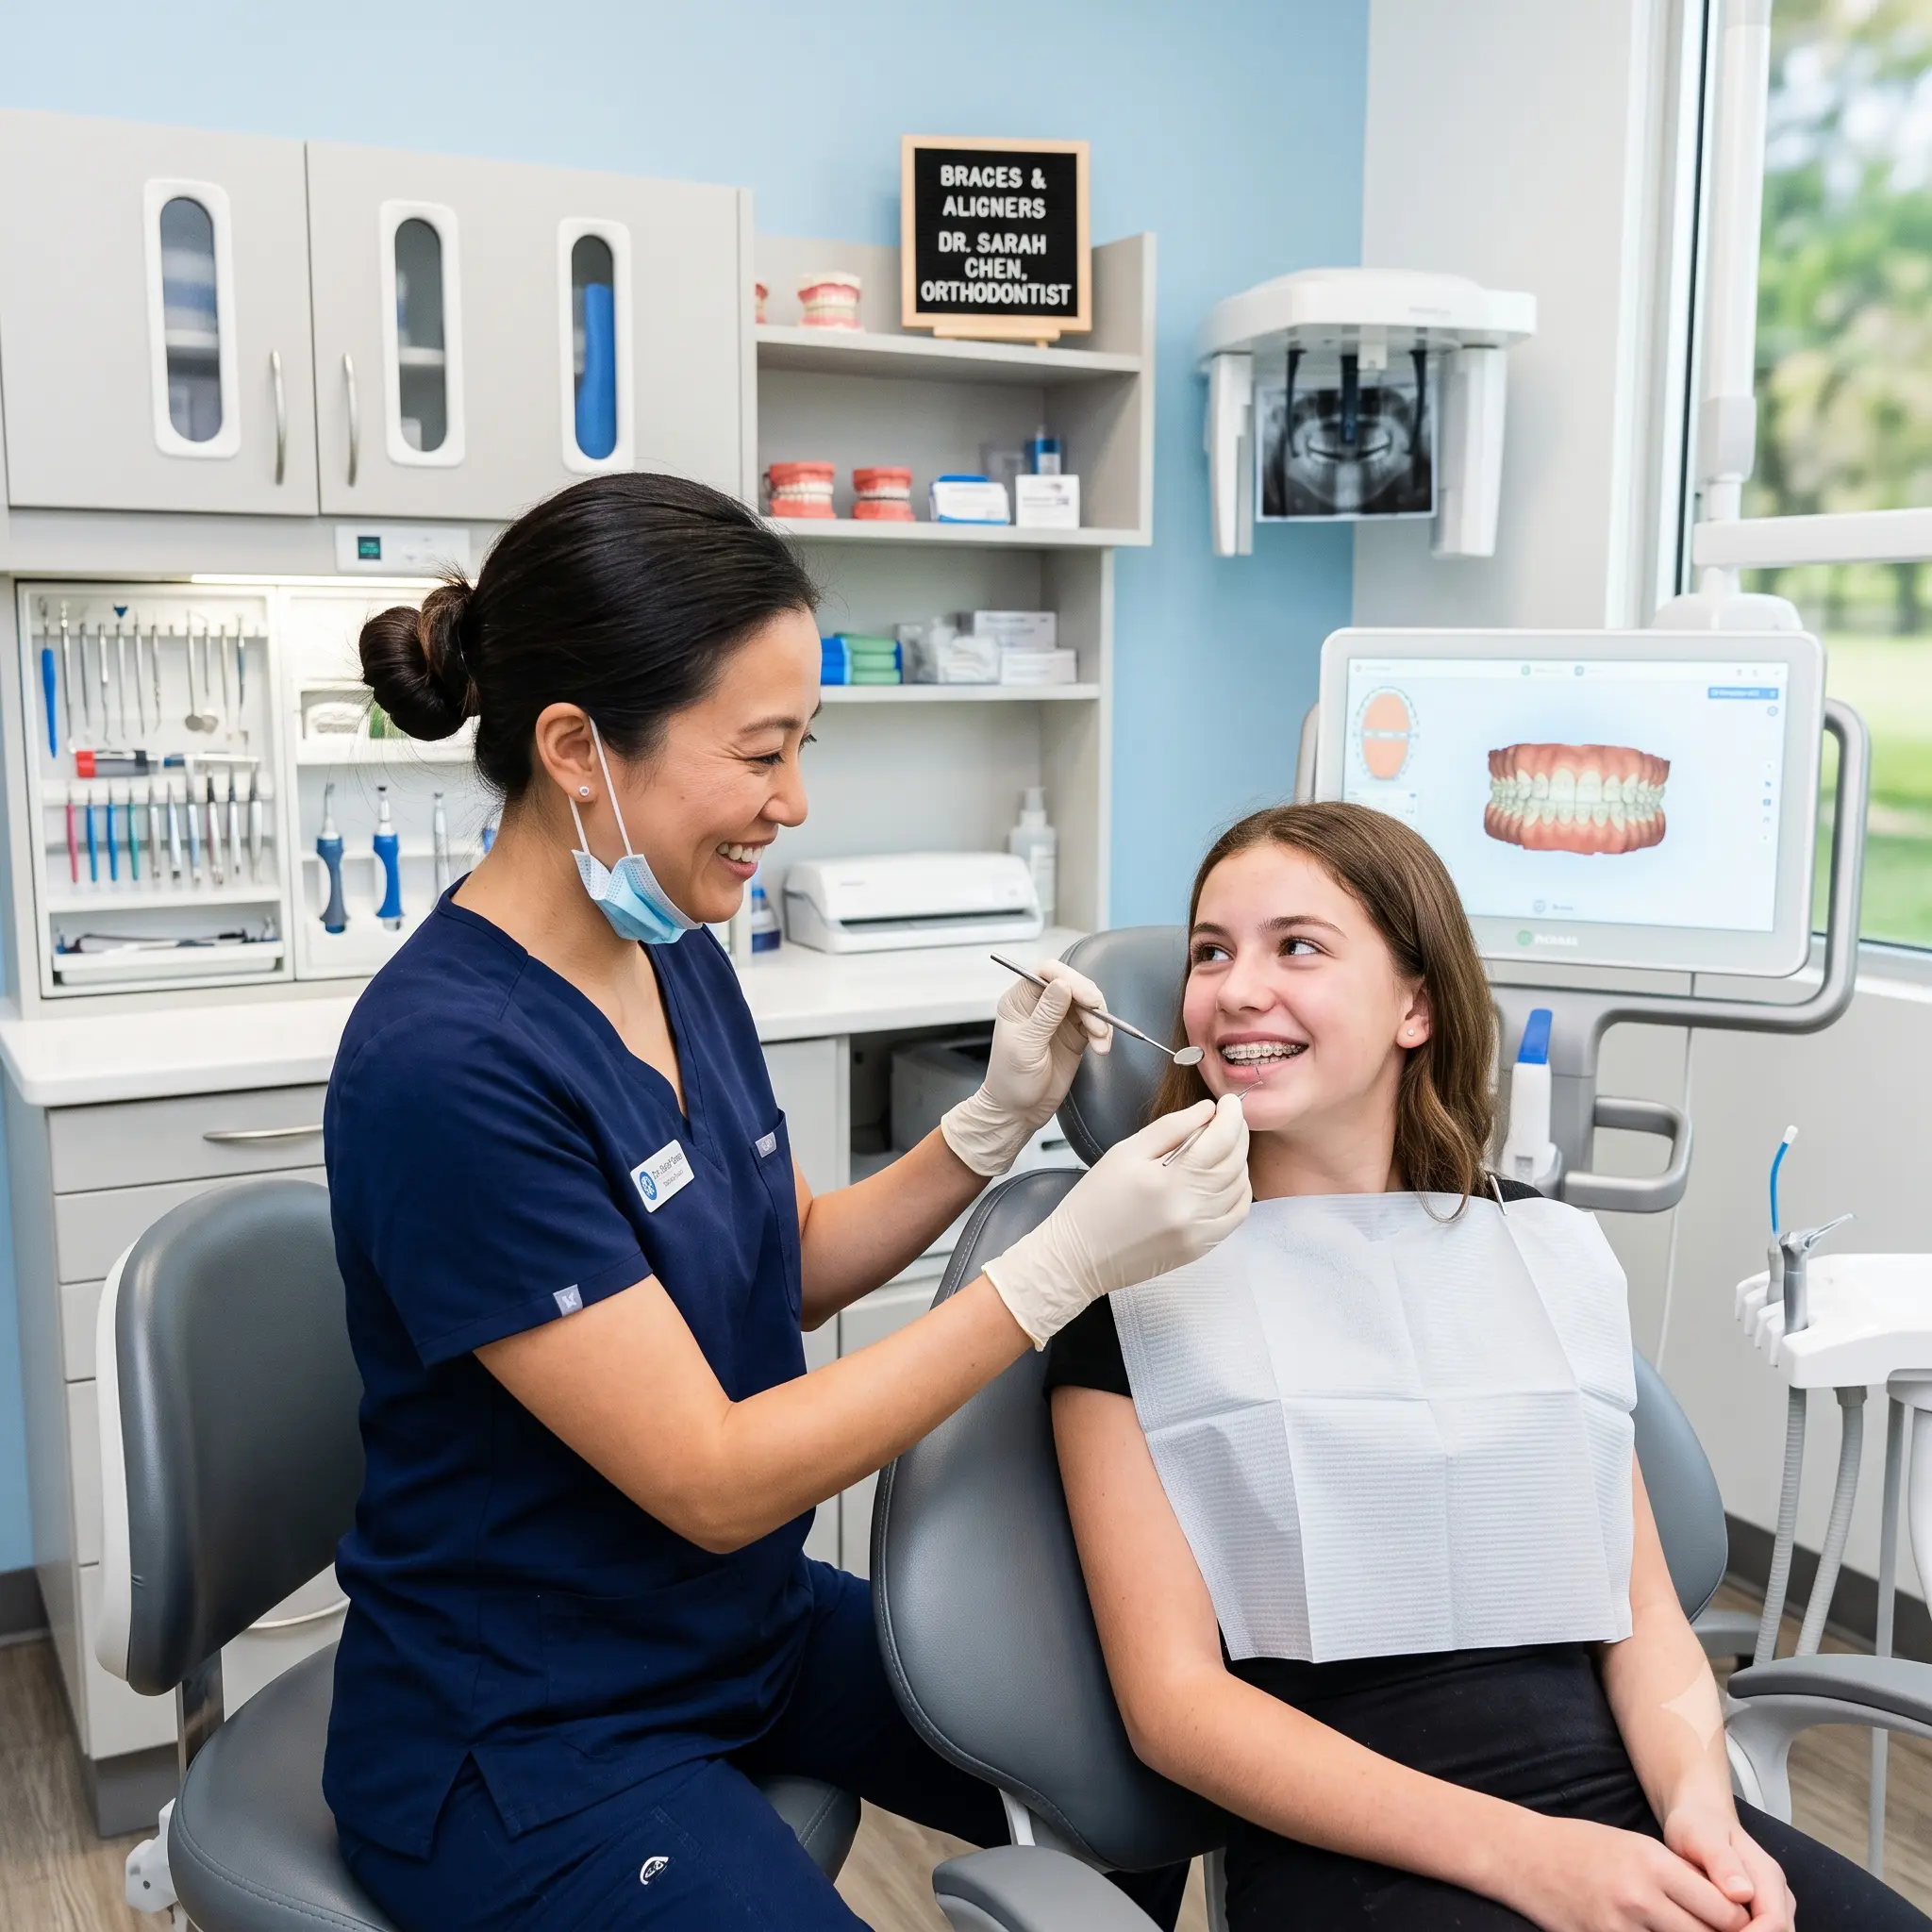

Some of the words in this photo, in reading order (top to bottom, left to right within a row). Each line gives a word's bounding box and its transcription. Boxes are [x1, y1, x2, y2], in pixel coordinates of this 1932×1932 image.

[940, 164, 1024, 189] BRACES
[1030, 167, 1047, 190] &
[941, 194, 1046, 220] ALIGNERS
[938, 230, 972, 254] DR.
[975, 232, 1047, 256] SARAH
[964, 257, 1028, 281] CHEN,
[920, 279, 1072, 306] ORTHODONTIST
